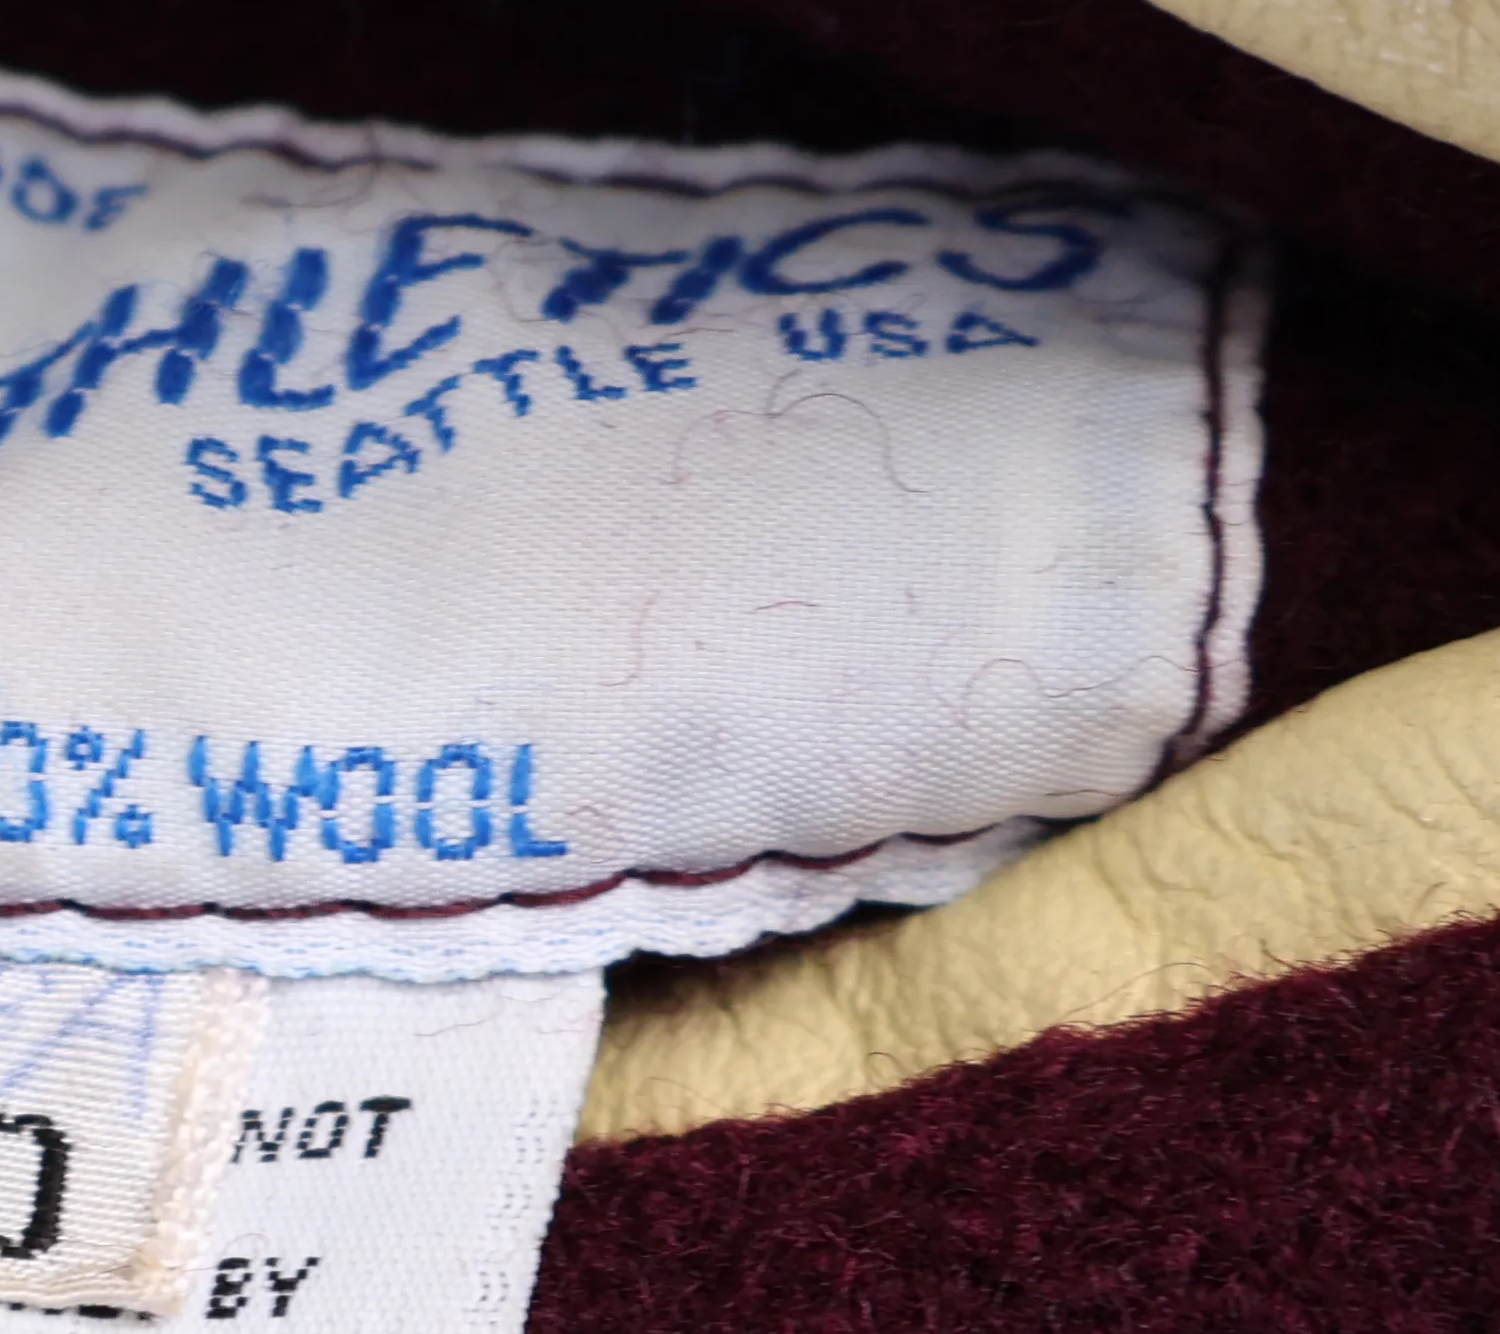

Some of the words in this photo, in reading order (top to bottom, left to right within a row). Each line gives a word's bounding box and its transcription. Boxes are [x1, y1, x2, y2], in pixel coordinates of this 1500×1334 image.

[185, 343, 699, 513] SEATTLE
[777, 309, 1038, 361] USA
[188, 734, 568, 865] WOOL
[231, 1095, 413, 1164] NOT
[205, 1256, 321, 1320] BY
